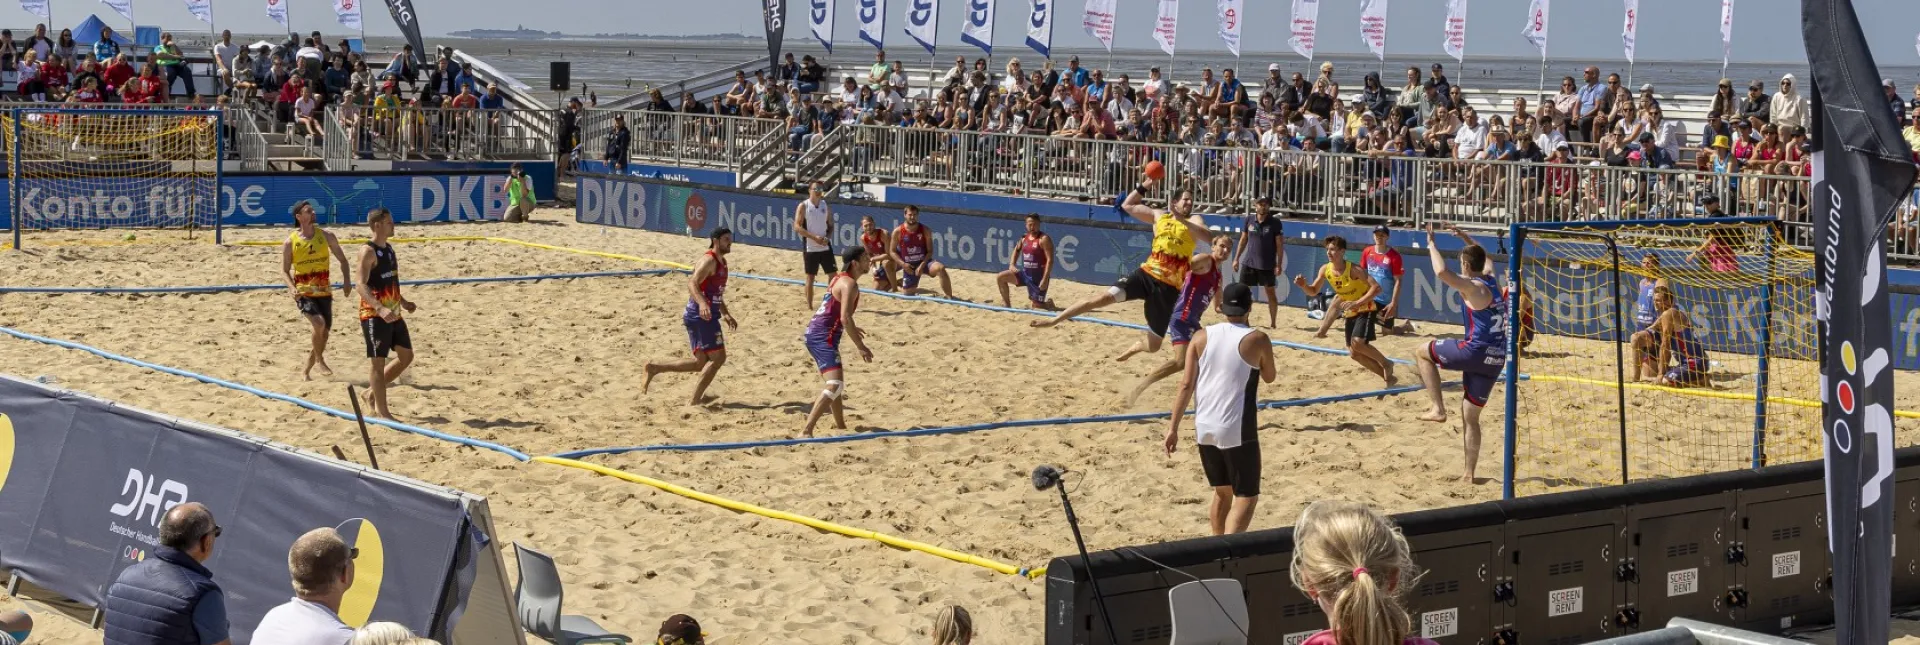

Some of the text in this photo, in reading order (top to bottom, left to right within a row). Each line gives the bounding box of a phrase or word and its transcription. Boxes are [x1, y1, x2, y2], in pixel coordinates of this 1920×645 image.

[20, 184, 267, 220] Konto für 0€
[411, 175, 511, 221] DKB
[582, 178, 646, 229] DKB
[688, 205, 704, 222] 0€
[983, 226, 1022, 267] fü
[1773, 554, 1799, 566] SCREEN
[1670, 571, 1697, 584] SCREEN
[1777, 564, 1795, 577] RENT
[1551, 588, 1582, 603] SCREEN
[1673, 582, 1693, 595] RENT
[1555, 601, 1577, 614] RENT
[1424, 610, 1457, 626] SCREEN
[1428, 624, 1451, 639] RENT
